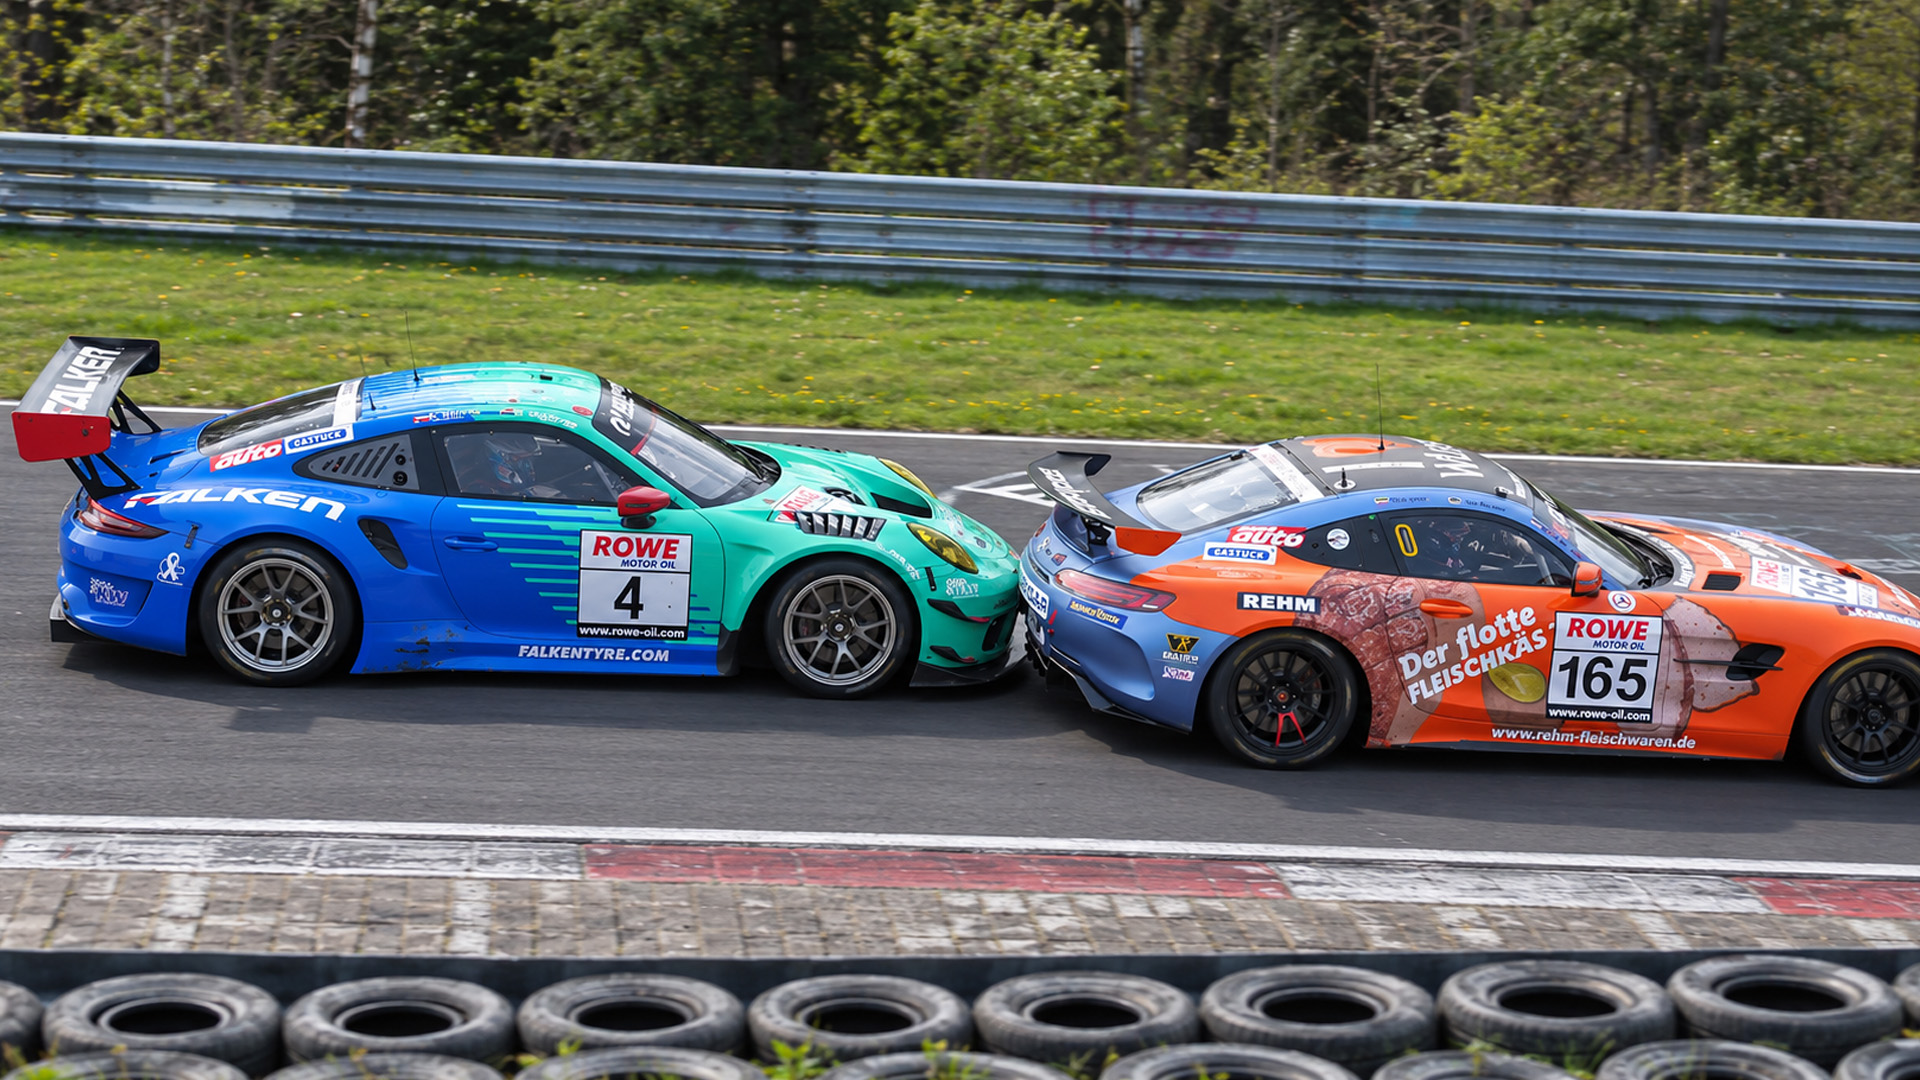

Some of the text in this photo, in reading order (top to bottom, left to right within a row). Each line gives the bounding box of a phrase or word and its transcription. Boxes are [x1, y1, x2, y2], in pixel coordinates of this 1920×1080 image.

[214, 443, 282, 470] auto
[123, 487, 347, 521] FALKEN
[592, 536, 680, 559] ROWE
[1232, 529, 1304, 547] auto
[621, 559, 676, 569] MOTOR OIL
[614, 576, 644, 620] 4
[1243, 594, 1316, 612] REHM
[579, 627, 685, 638] www.rowe-oil.com
[1567, 618, 1649, 641] ROWE
[1398, 606, 1536, 680] Der flotte
[1593, 640, 1645, 650] MOTOR OIL
[518, 645, 669, 662] FALKENTYRE.COM
[1559, 656, 1649, 701] 165
[1549, 708, 1651, 721] www.rowe-oil.com
[1491, 728, 1696, 748] www.rehm-fleischwaren.de
